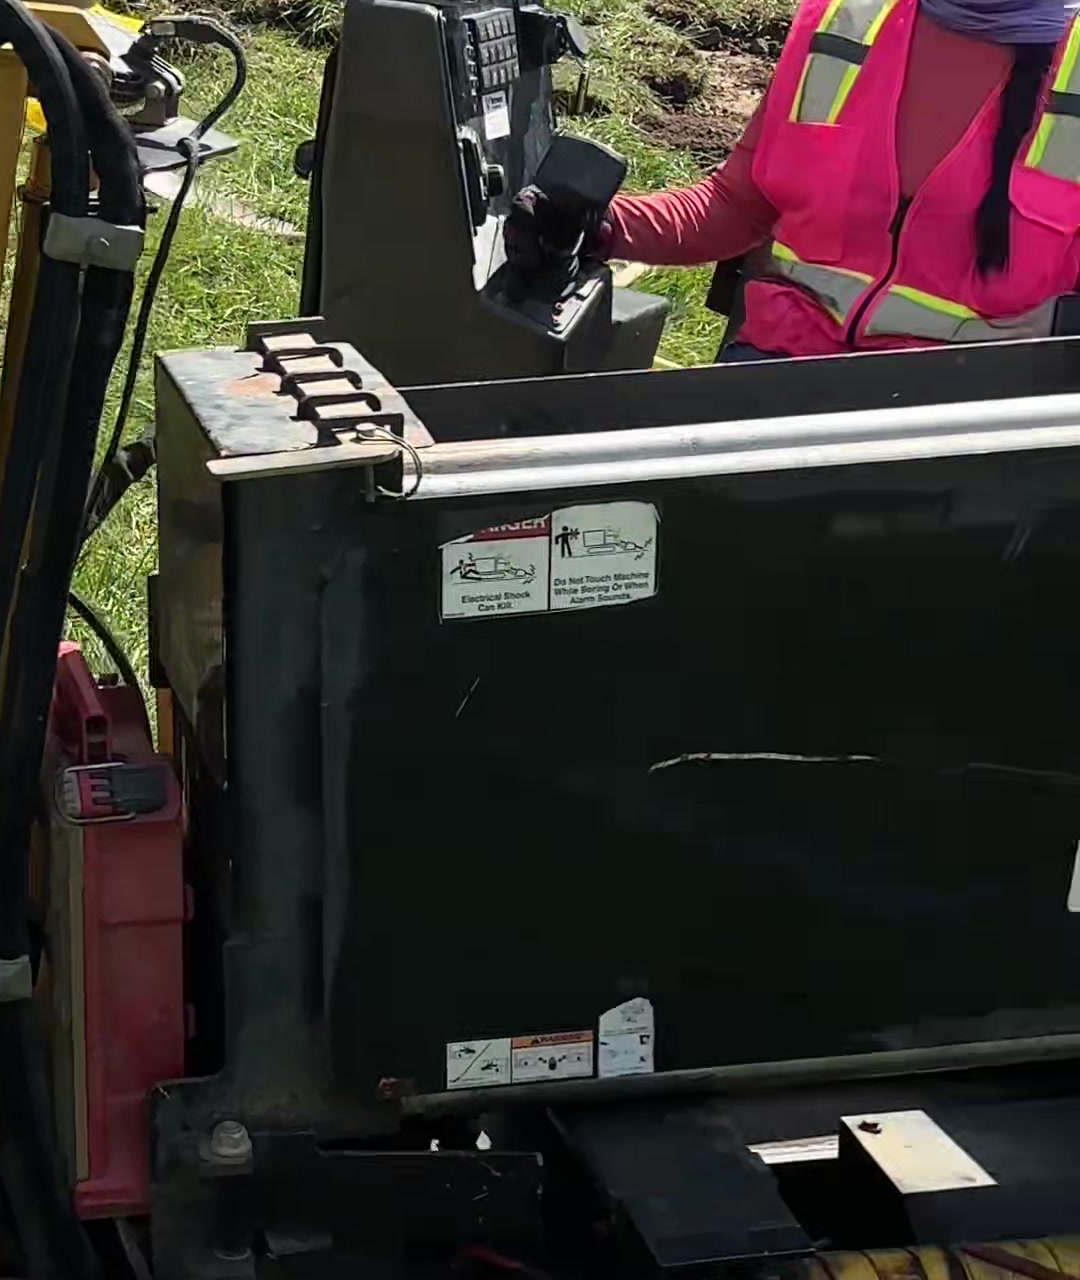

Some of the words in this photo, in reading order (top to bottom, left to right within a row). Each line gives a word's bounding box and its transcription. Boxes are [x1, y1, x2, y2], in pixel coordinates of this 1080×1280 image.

[569, 577, 584, 585] Not
[585, 575, 612, 583] Touch
[613, 572, 650, 581] Machine
[553, 587, 579, 595] While
[581, 585, 610, 594] Boring
[612, 583, 623, 591] Or
[624, 582, 649, 590] When
[461, 593, 502, 604] Electrical
[503, 591, 531, 600] Shock
[569, 595, 595, 604] Alarm
[477, 603, 496, 612] Can
